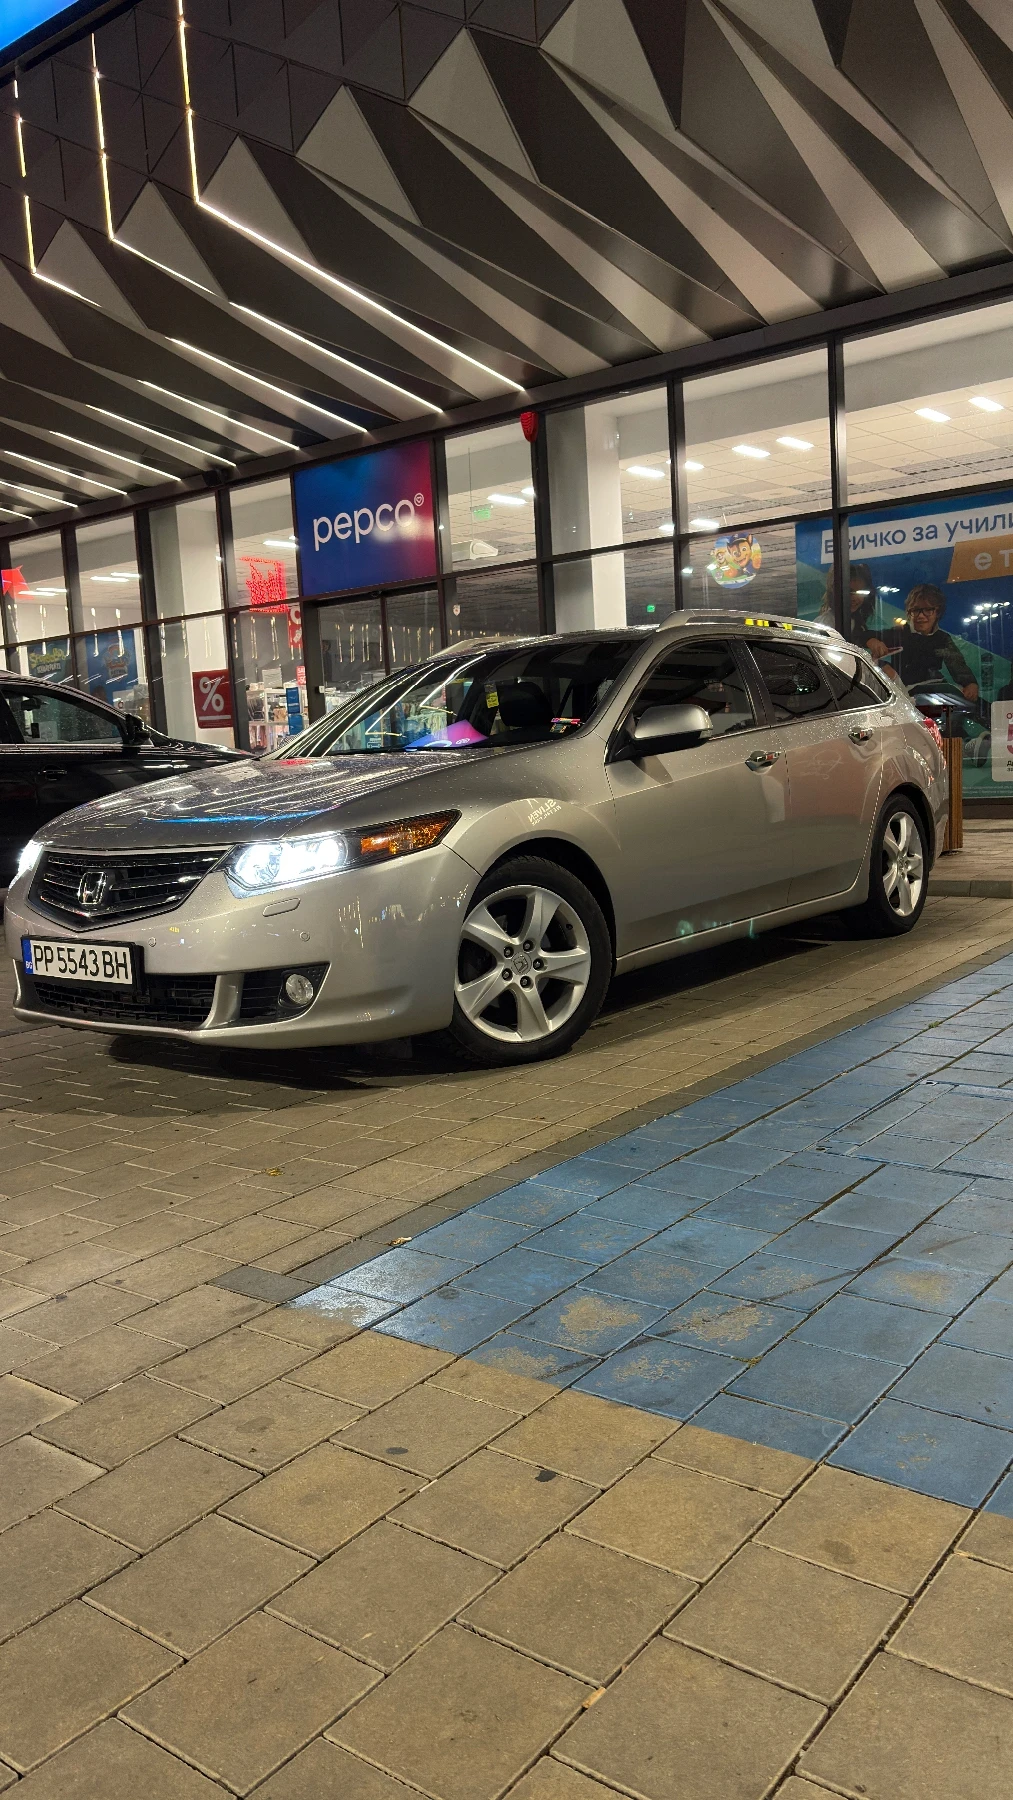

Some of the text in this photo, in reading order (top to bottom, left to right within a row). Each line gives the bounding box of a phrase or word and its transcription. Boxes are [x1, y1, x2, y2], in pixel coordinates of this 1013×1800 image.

[313, 499, 415, 552] pepco
[824, 529, 906, 554] вичко
[912, 524, 938, 542] за
[25, 960, 33, 970] BG
[33, 944, 129, 980] PP 5543 BH
